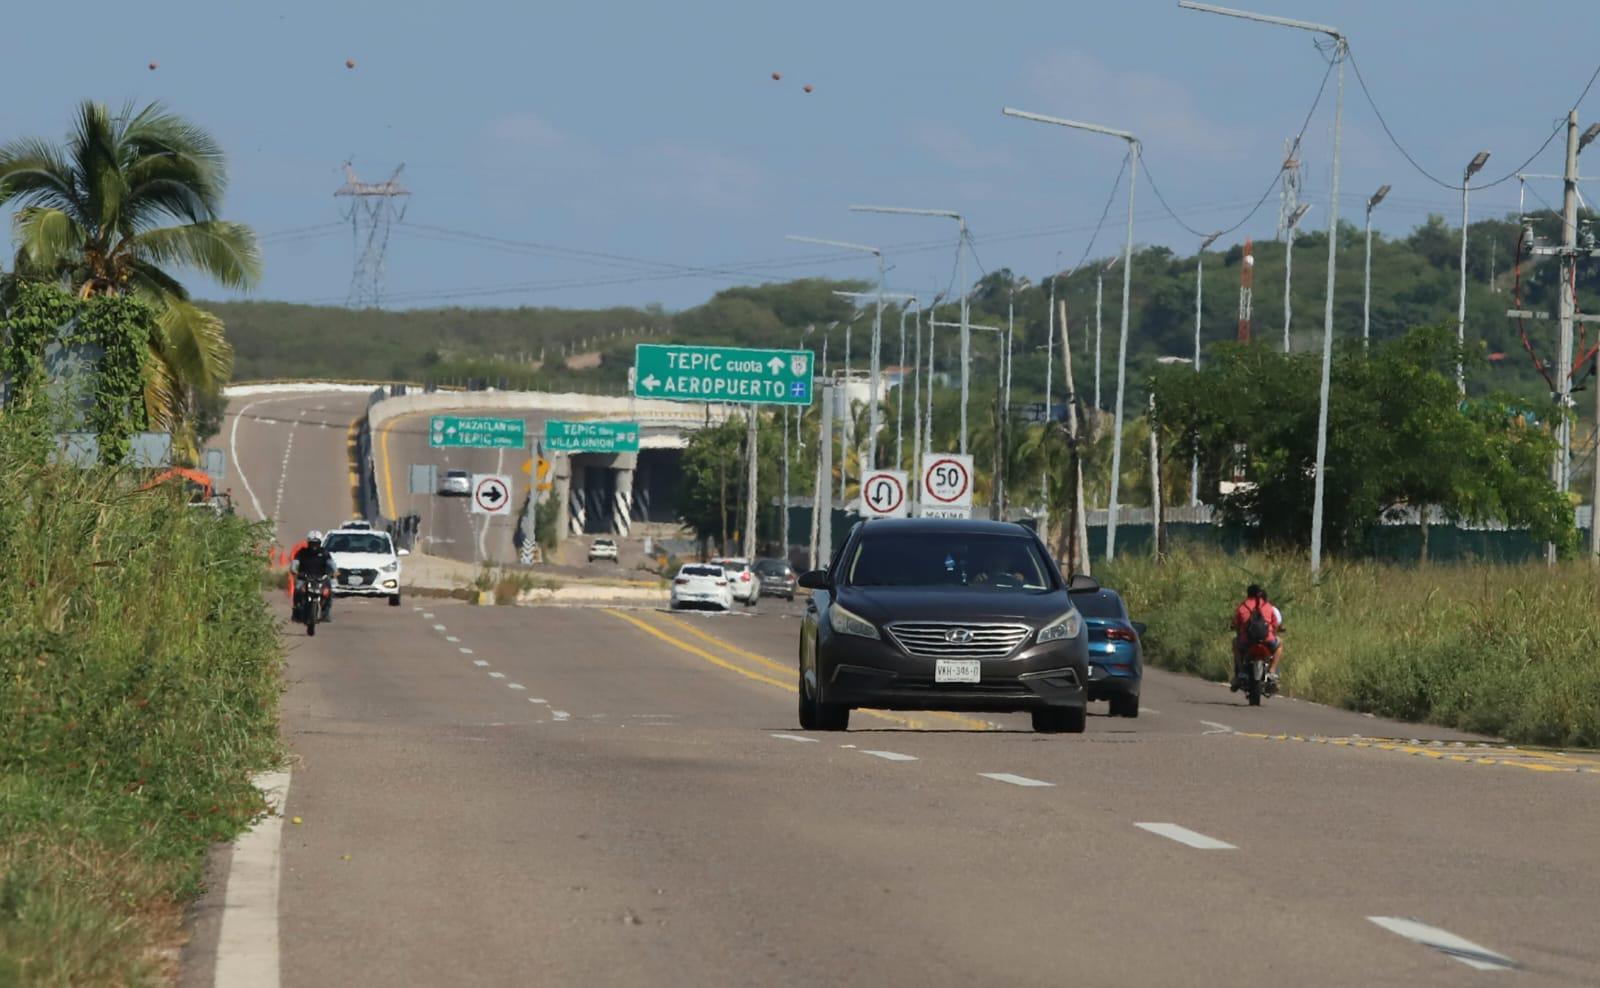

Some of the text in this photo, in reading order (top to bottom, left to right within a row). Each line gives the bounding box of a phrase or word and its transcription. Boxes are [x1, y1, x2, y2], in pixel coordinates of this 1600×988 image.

[667, 352, 763, 373] TEPIC cuota
[664, 376, 785, 398] AEROPUERTO
[458, 432, 492, 445] TEPIC
[563, 424, 597, 436] TEPIC
[551, 437, 579, 447] VILLA
[936, 467, 959, 488] 50
